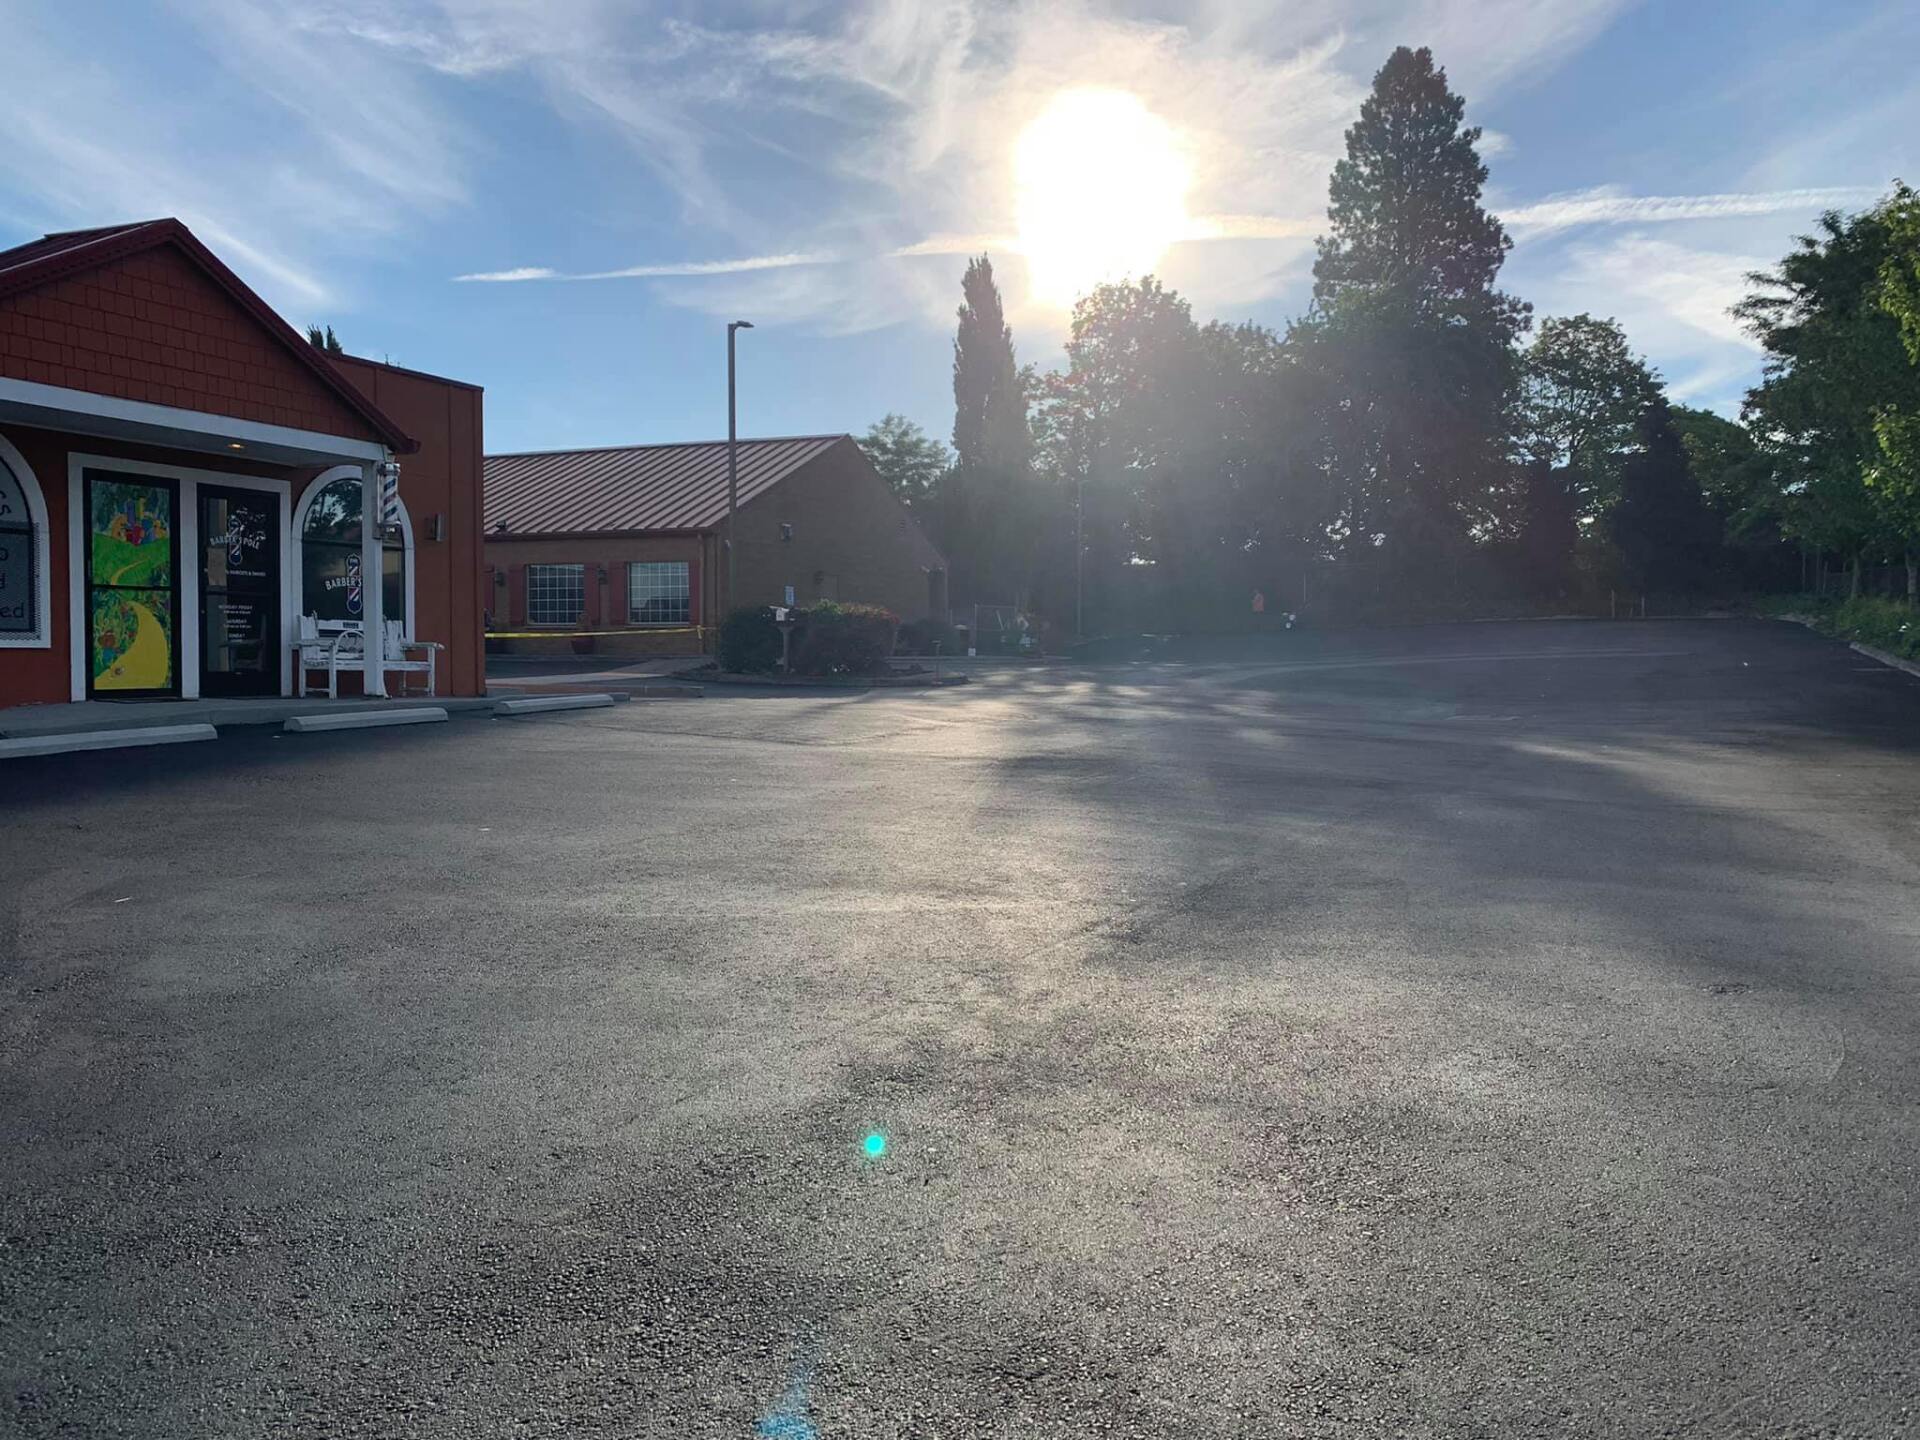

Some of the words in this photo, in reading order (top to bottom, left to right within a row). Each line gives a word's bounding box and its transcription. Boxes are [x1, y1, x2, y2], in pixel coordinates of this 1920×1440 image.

[210, 535, 242, 545] BARBER'S
[243, 537, 259, 549] POLE
[325, 577, 362, 590] BARBER'S
